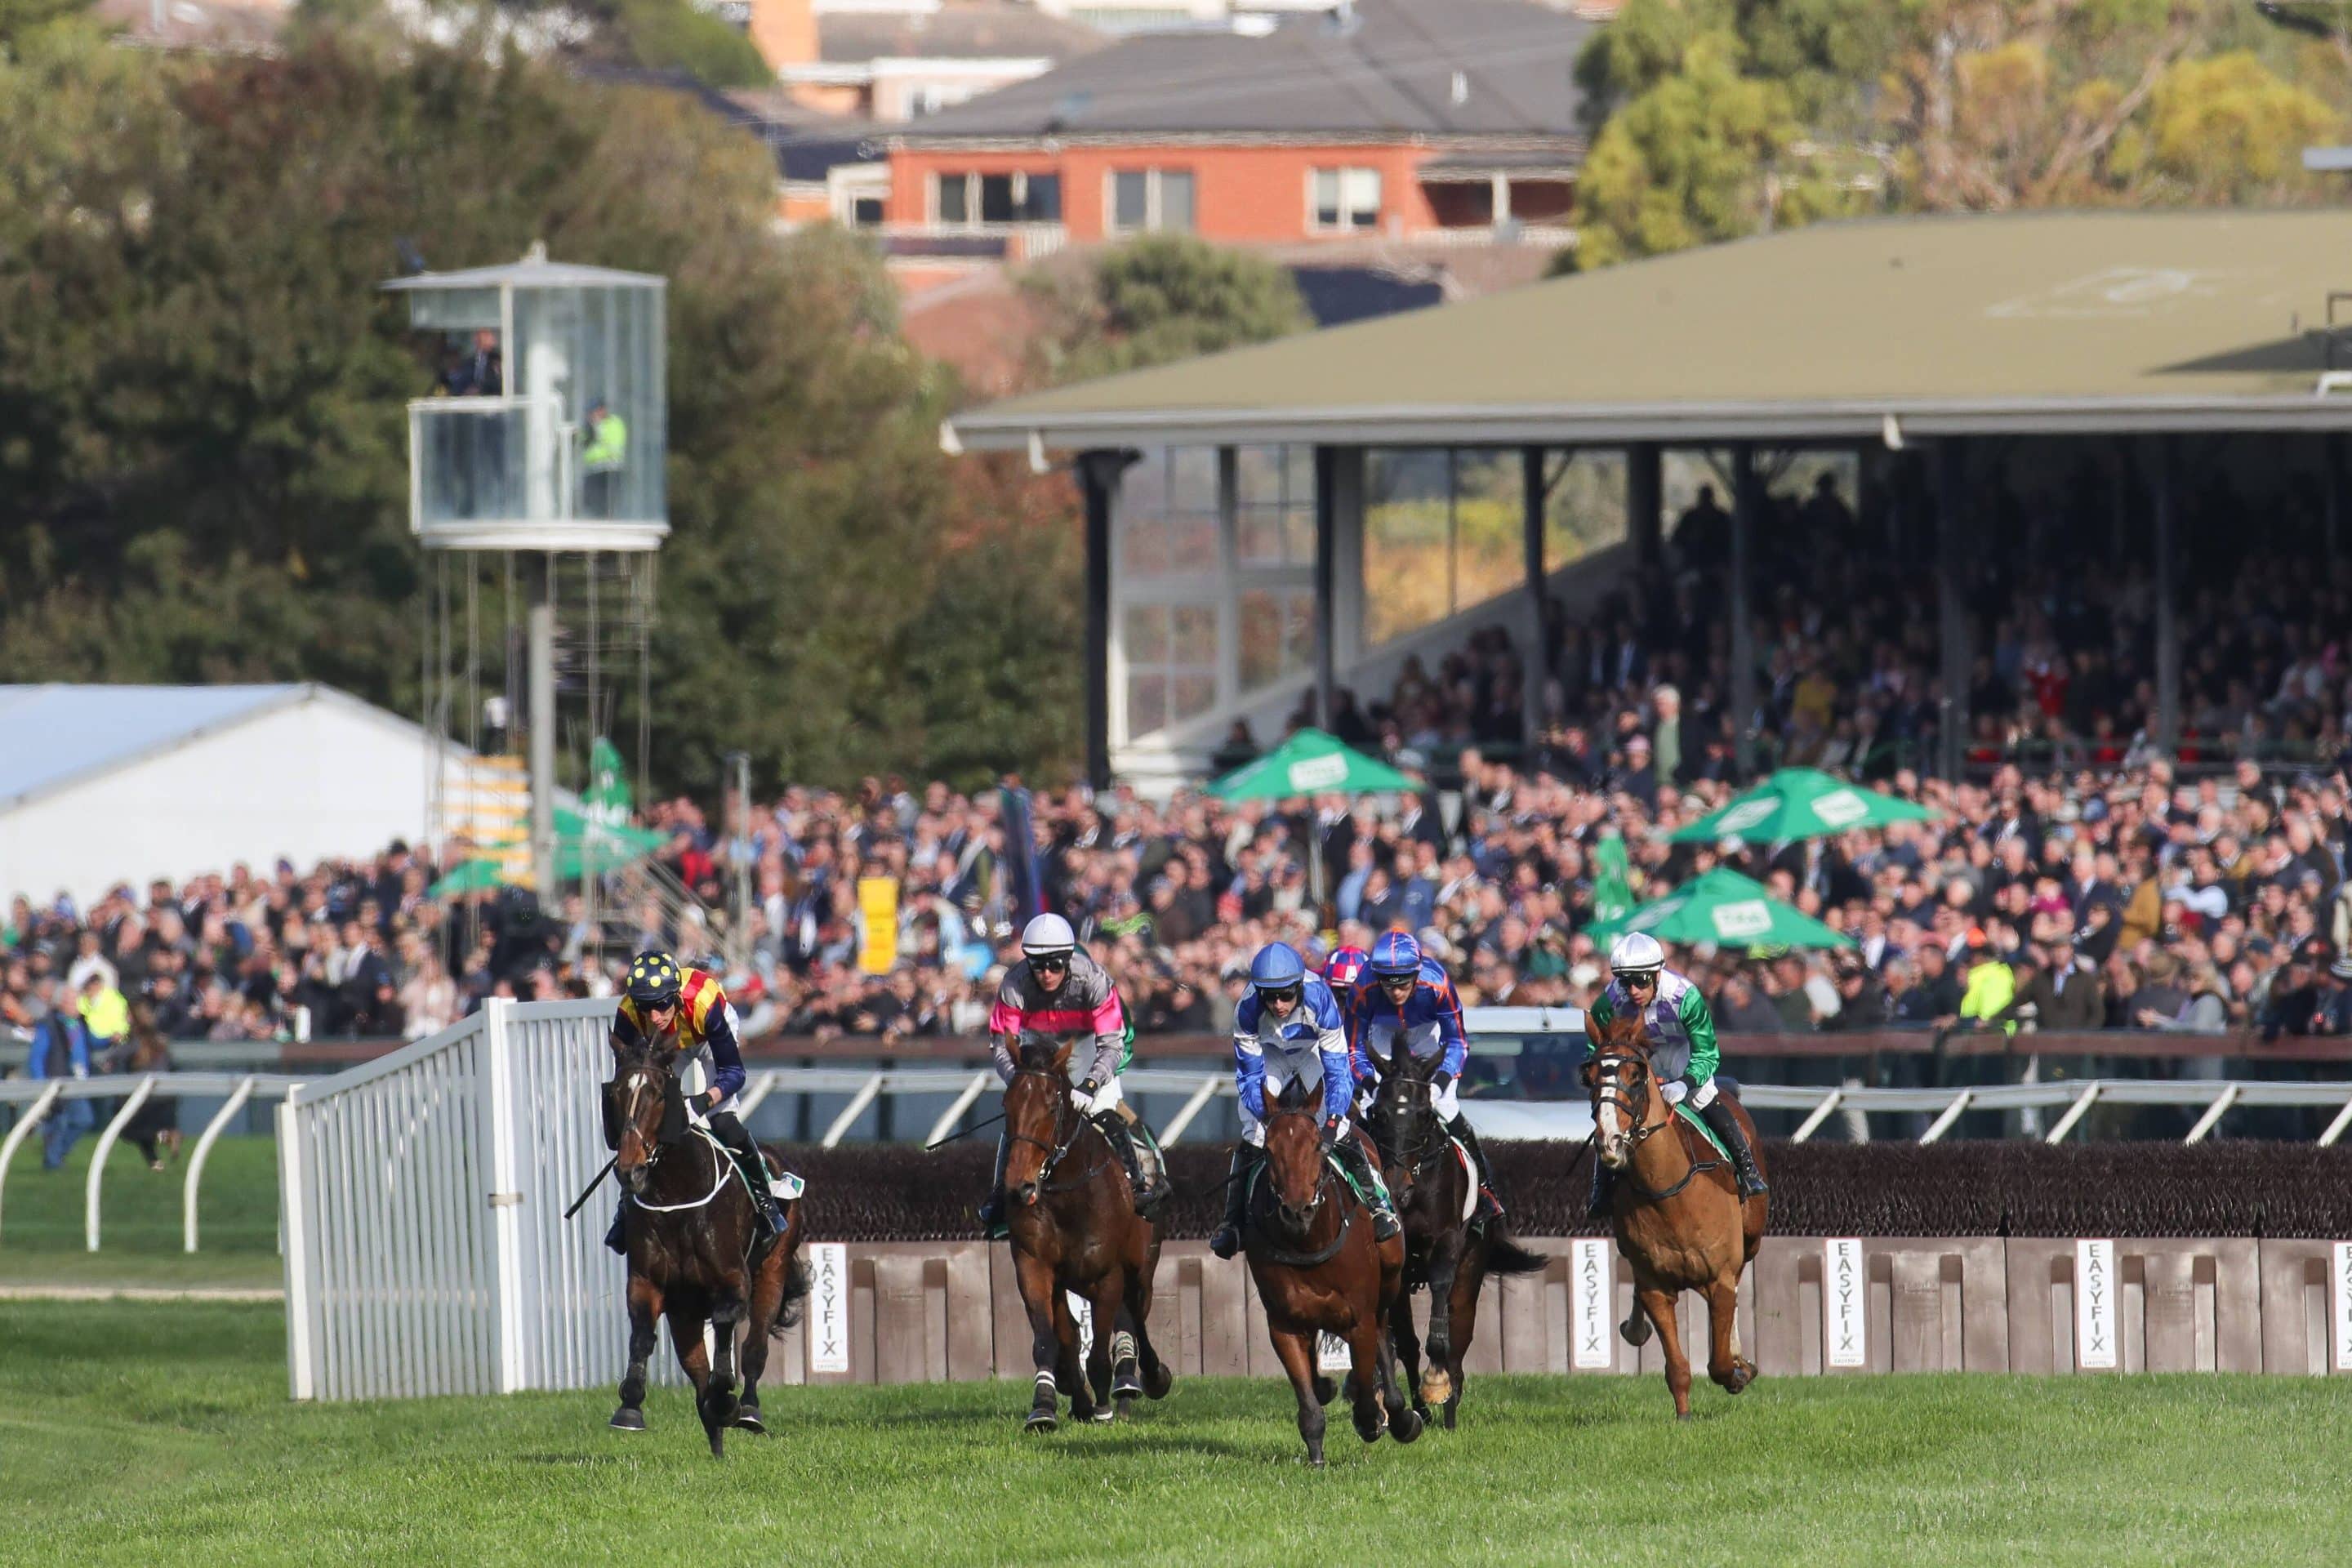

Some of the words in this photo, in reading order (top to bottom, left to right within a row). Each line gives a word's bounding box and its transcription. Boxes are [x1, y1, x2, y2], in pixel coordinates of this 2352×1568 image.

[821, 1248, 836, 1356] EASYFIX
[1583, 1244, 1599, 1352] EASYFIX
[1838, 1242, 1854, 1352] EASYFIX
[2088, 1244, 2105, 1352] EASYFIX
